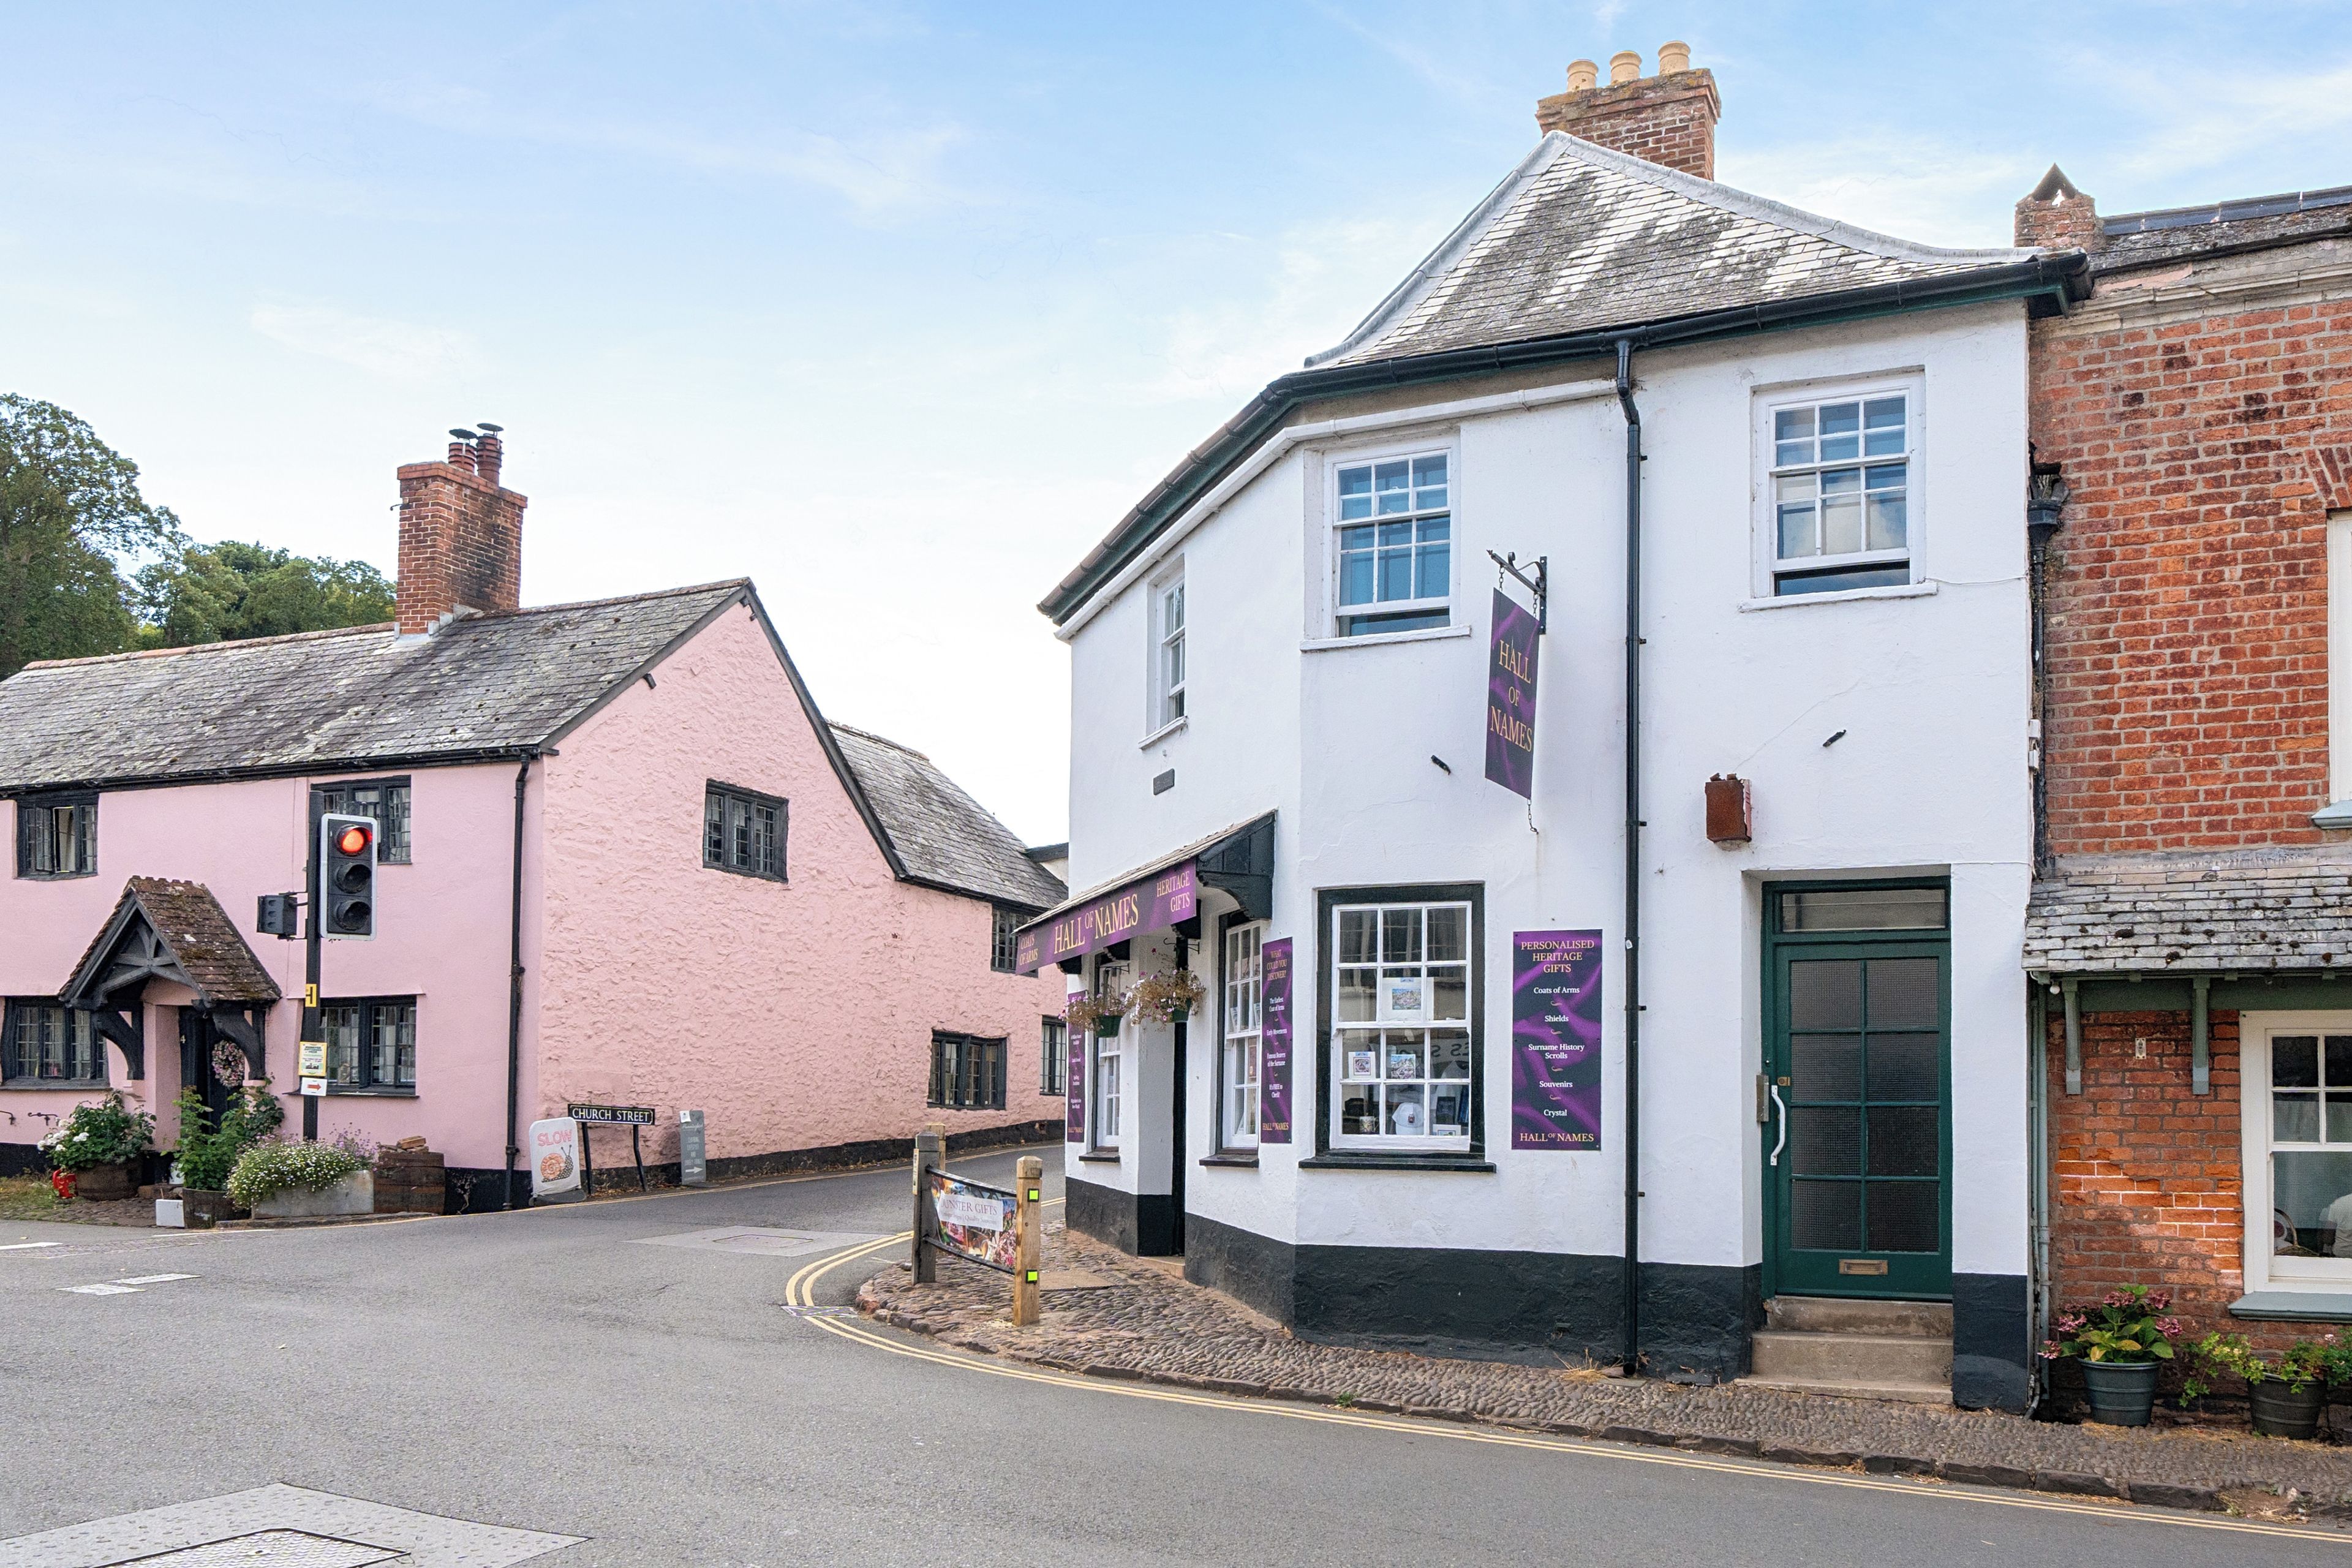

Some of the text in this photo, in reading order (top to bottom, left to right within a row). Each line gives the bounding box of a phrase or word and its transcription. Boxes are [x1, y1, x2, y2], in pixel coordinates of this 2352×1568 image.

[1499, 639, 1531, 684] HALL
[1508, 686, 1520, 706] OF
[1490, 706, 1532, 752] NAMES
[1156, 870, 1190, 897] HERITAGE
[1170, 892, 1190, 913] GIFTS
[1054, 893, 1139, 954] HALL OF NAMES
[1020, 933, 1035, 949] COATS
[1521, 940, 1595, 950] PERSONALISED
[1532, 952, 1583, 962] HERITAGE
[1544, 964, 1572, 973] GIFTS
[1559, 1043, 1585, 1052] History
[572, 1108, 649, 1122] CHURCH STREET
[1544, 1109, 1567, 1118] Crystal
[1275, 1122, 1289, 1131] NAMES
[537, 1129, 573, 1147] SLOW
[1520, 1133, 1548, 1142] HALL
[1557, 1133, 1594, 1142] NAMES
[974, 1204, 997, 1216] GIFTS
